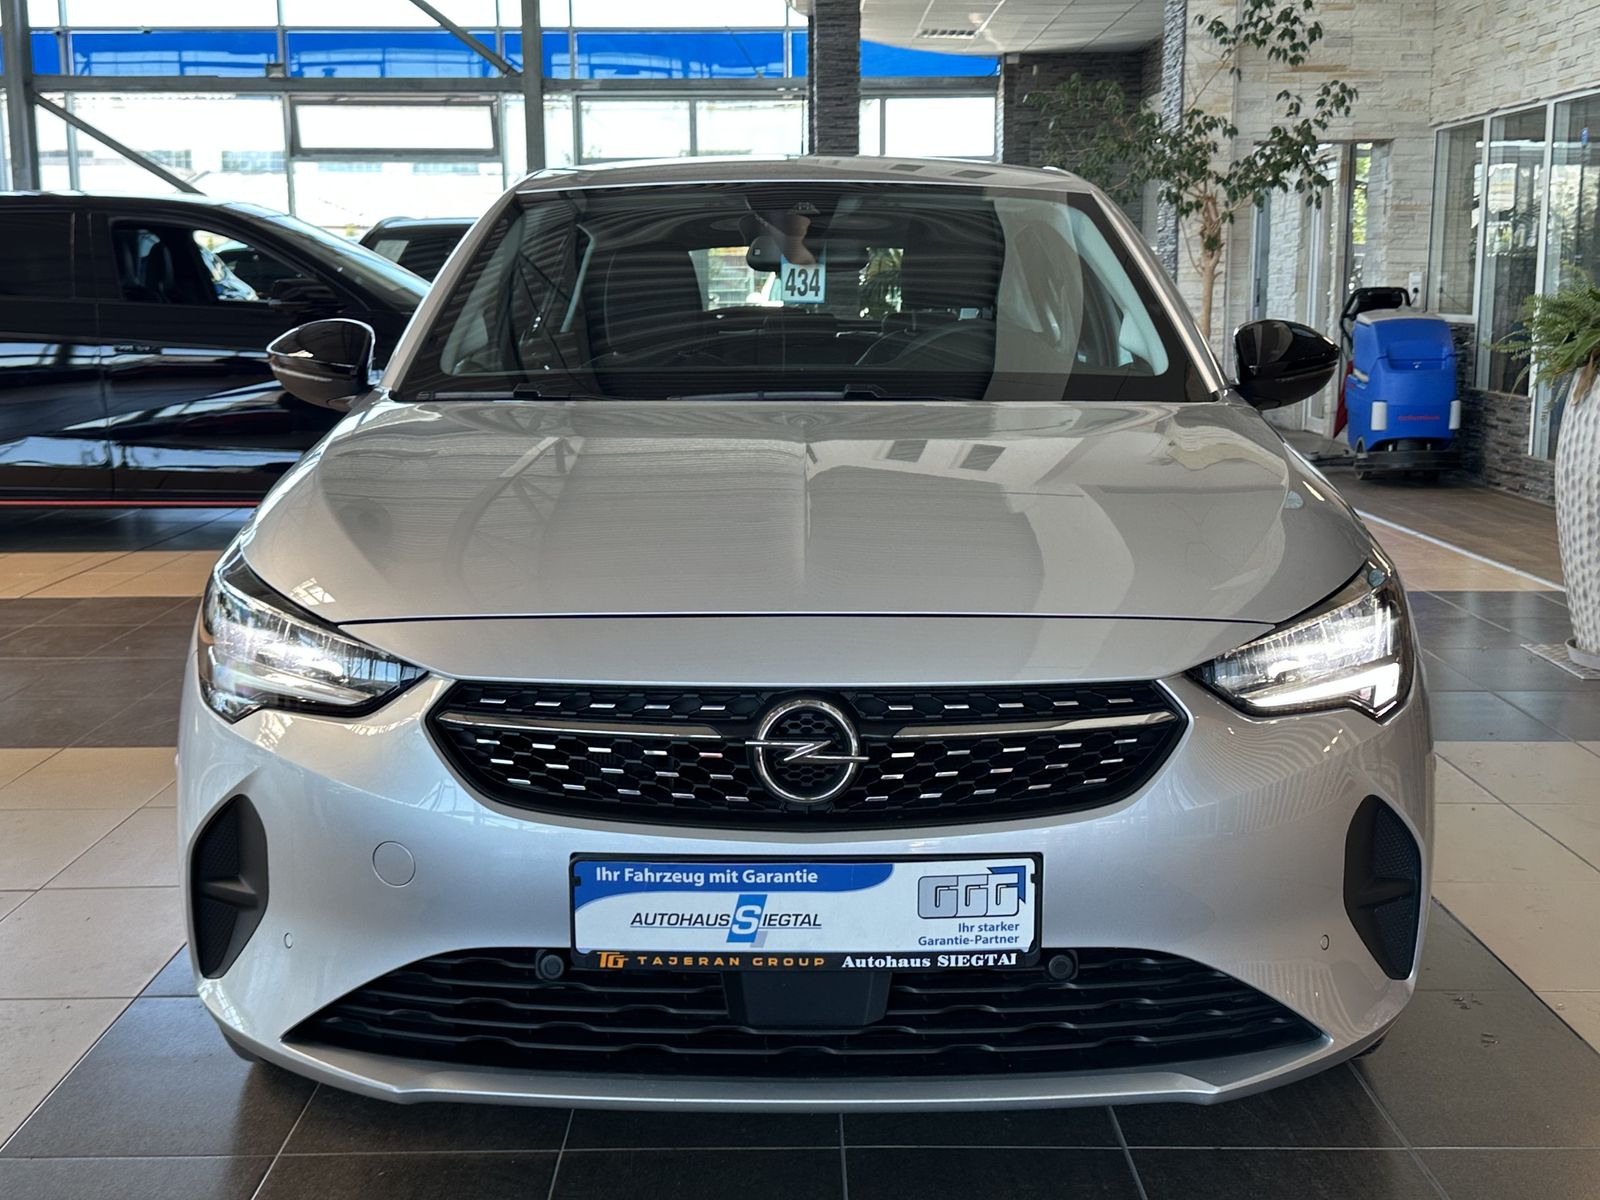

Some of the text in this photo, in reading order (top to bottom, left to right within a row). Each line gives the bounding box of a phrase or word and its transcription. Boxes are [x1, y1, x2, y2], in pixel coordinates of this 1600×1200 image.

[785, 268, 820, 297] 434
[596, 867, 818, 886] Ihr Fahrzeug mit Garantie
[958, 921, 1020, 933] Ihr starker
[918, 935, 1020, 946] Garantie-Partner
[637, 956, 741, 967] TAJERAN
[753, 957, 825, 968] GROUP
[841, 955, 931, 969] Autohaus
